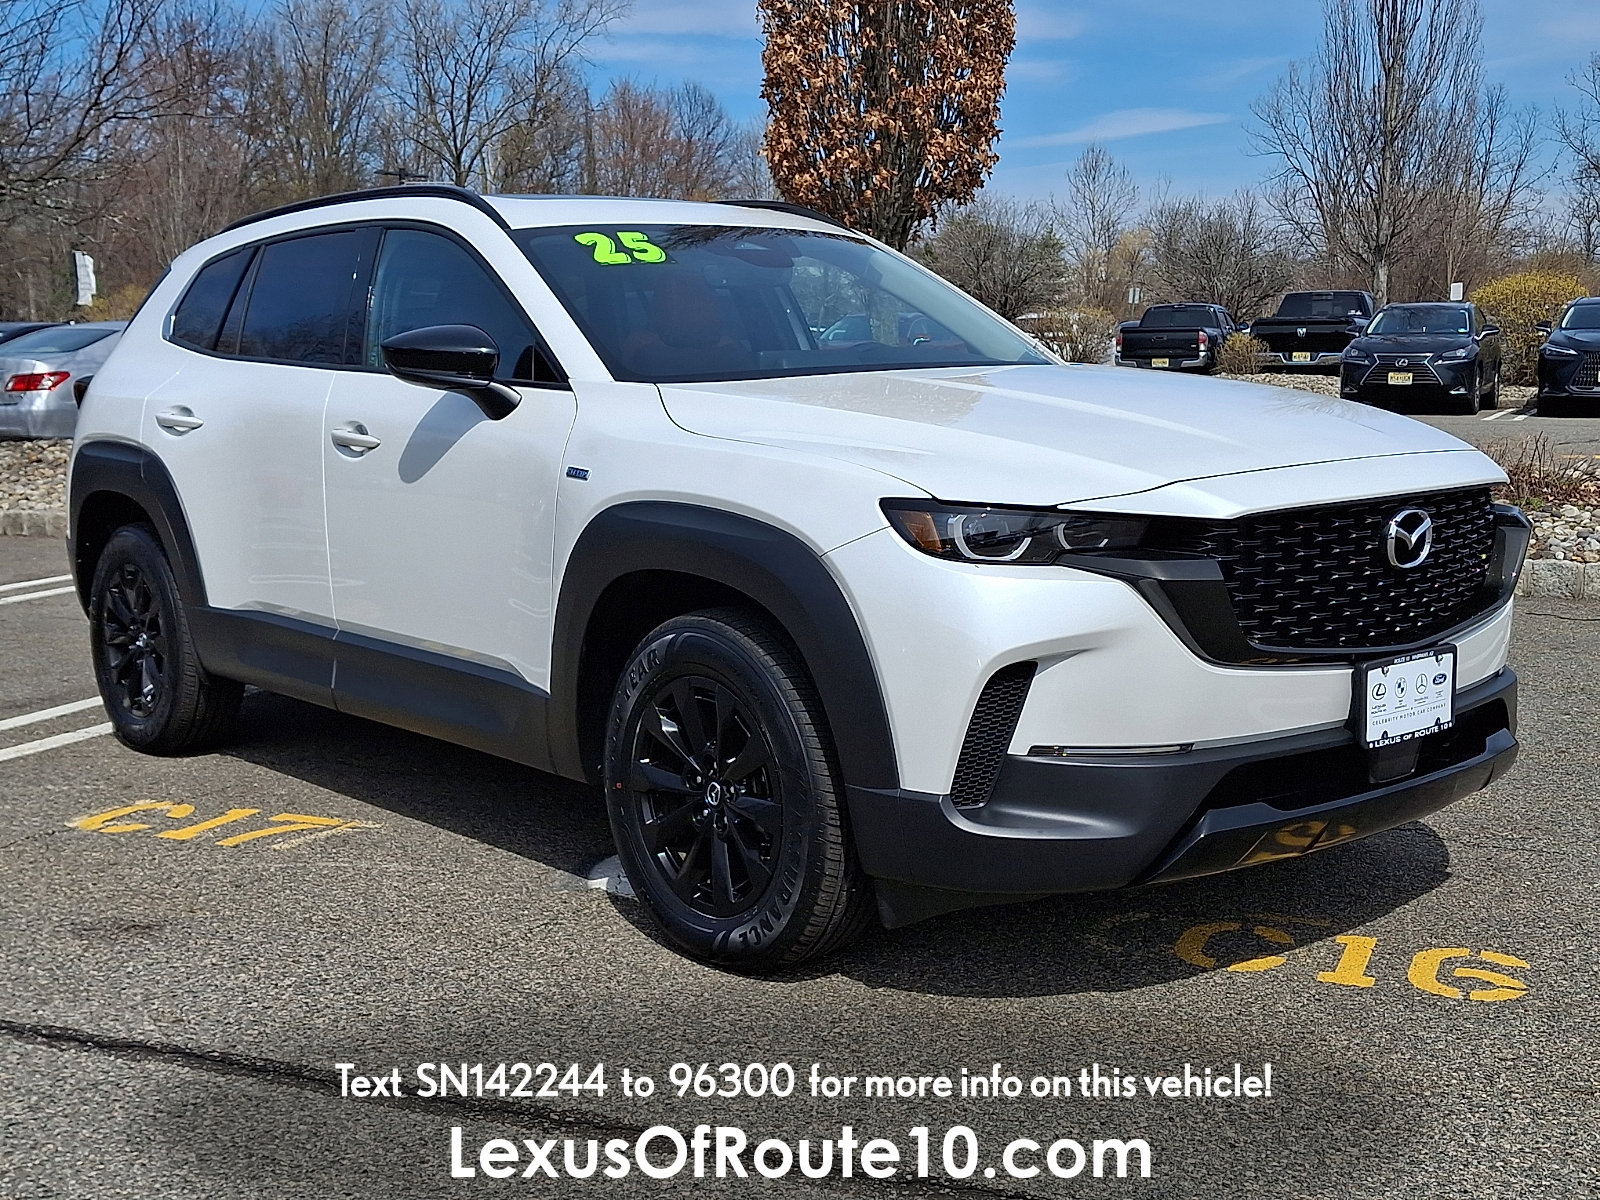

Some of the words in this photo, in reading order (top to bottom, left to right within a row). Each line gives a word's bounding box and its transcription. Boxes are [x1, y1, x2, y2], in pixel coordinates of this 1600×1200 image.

[575, 231, 667, 265] 25
[1372, 716, 1398, 726] CELEBRITY
[1399, 711, 1416, 719] MOTOR
[1426, 703, 1446, 713] COMPANY
[1375, 736, 1401, 748] LEXUS
[1414, 726, 1439, 738] ROUTE
[76, 800, 358, 847] C17
[1174, 921, 1531, 1001] C16
